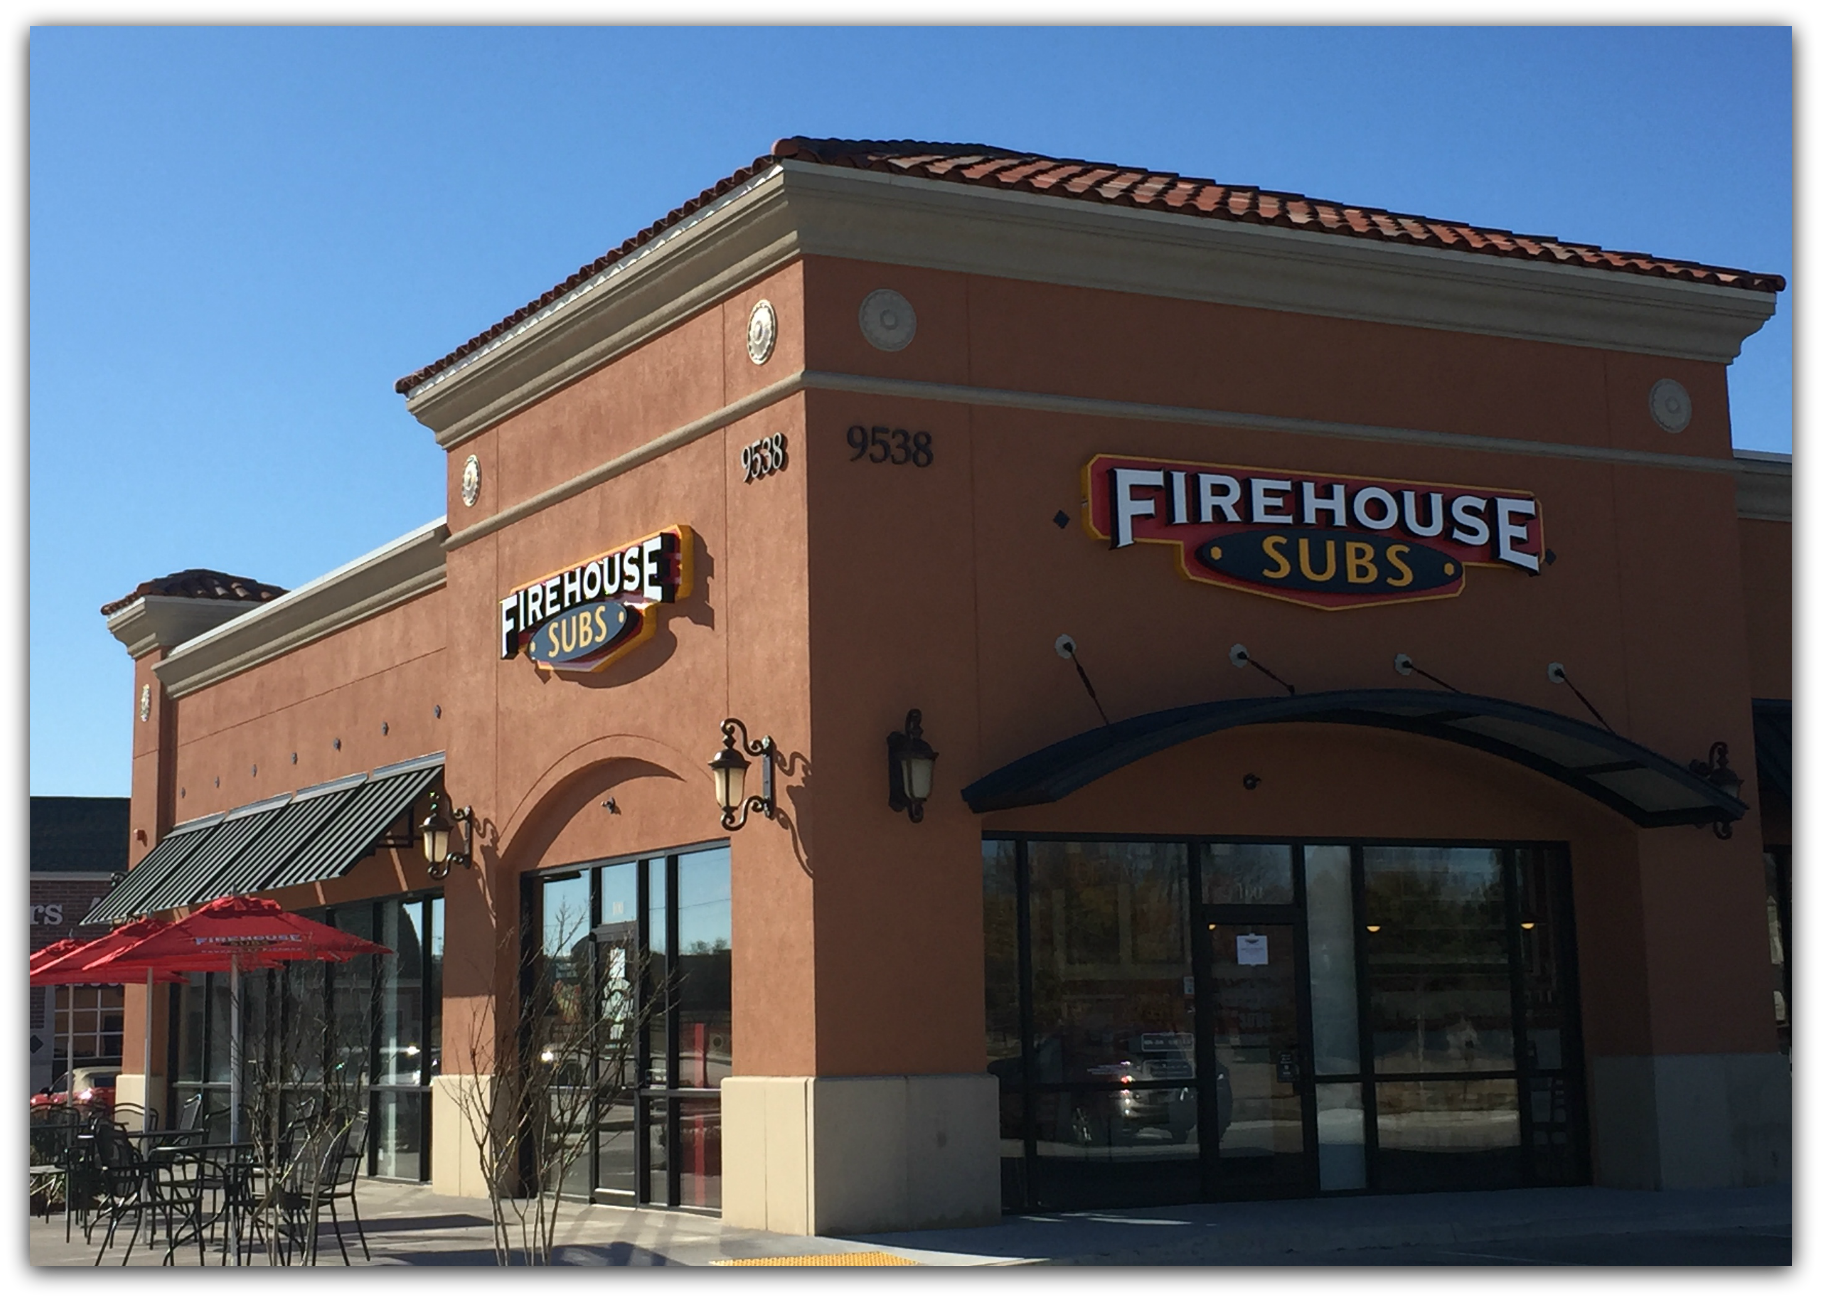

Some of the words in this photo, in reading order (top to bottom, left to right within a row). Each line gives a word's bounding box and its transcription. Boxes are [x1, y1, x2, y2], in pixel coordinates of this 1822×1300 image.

[740, 431, 785, 481] 9538
[846, 425, 935, 467] 9538
[1112, 468, 1541, 572] FIREHOUSE
[1261, 534, 1414, 587] SUBS
[500, 536, 664, 658] FIREHOUSE
[547, 605, 608, 658] SUBS
[195, 933, 302, 945] FIREHOUSE
